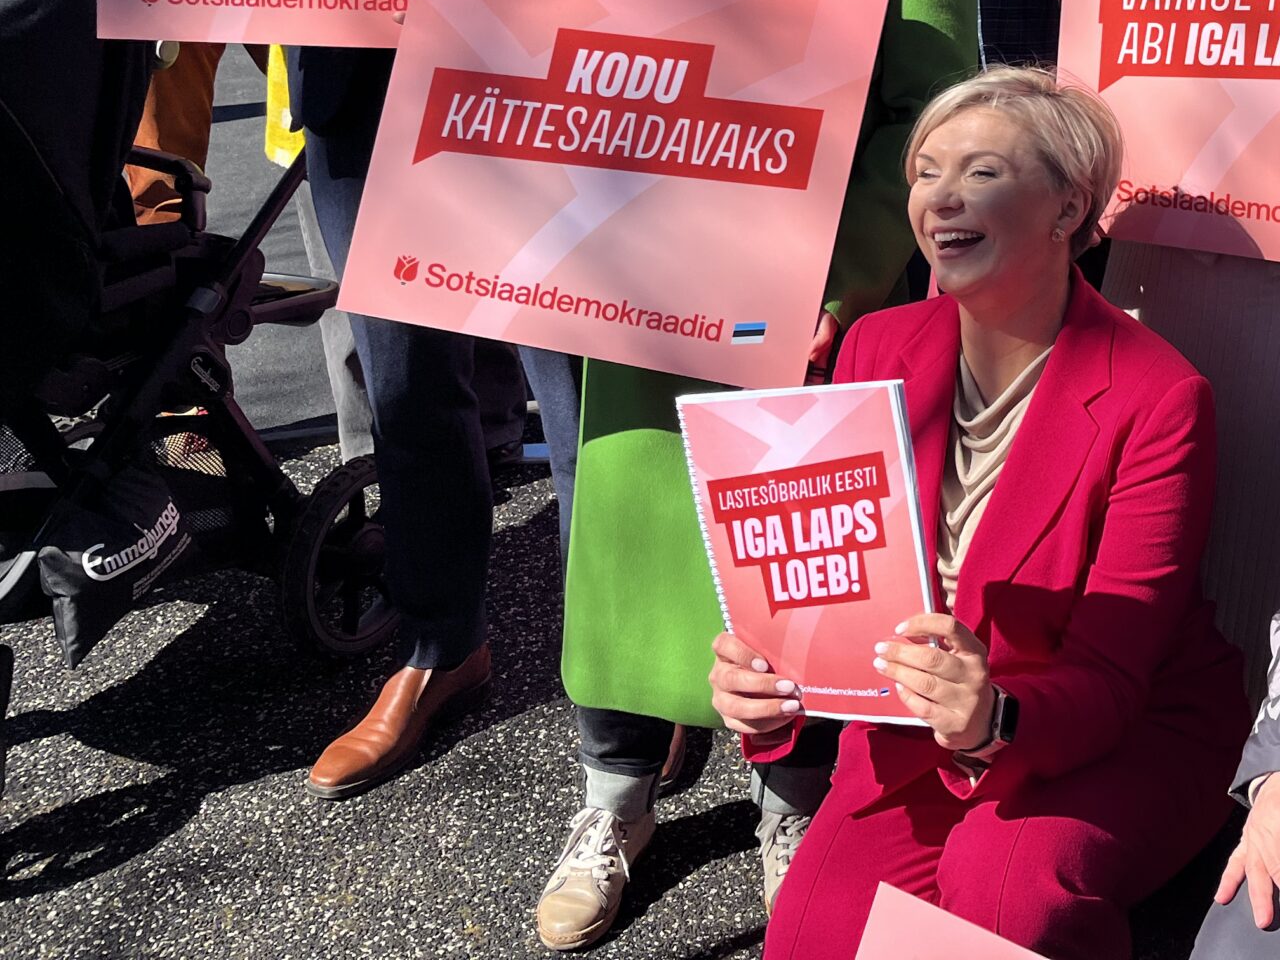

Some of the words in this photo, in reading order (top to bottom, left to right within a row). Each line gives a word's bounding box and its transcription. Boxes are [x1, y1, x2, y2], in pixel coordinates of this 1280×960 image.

[1117, 22, 1176, 65] ABI
[1184, 23, 1246, 67] IGA
[565, 48, 690, 104] KODU
[441, 88, 796, 174] KÄTTESAADAVAKS
[424, 263, 724, 343] Sotsiaaldemokraadid
[718, 475, 831, 510] LASTESÕBRALIK
[835, 466, 877, 492] EESTI
[82, 496, 181, 581] Emmaljunga
[732, 515, 787, 560] IGA
[791, 499, 878, 553] LAPS
[769, 551, 860, 602] LOEB!
